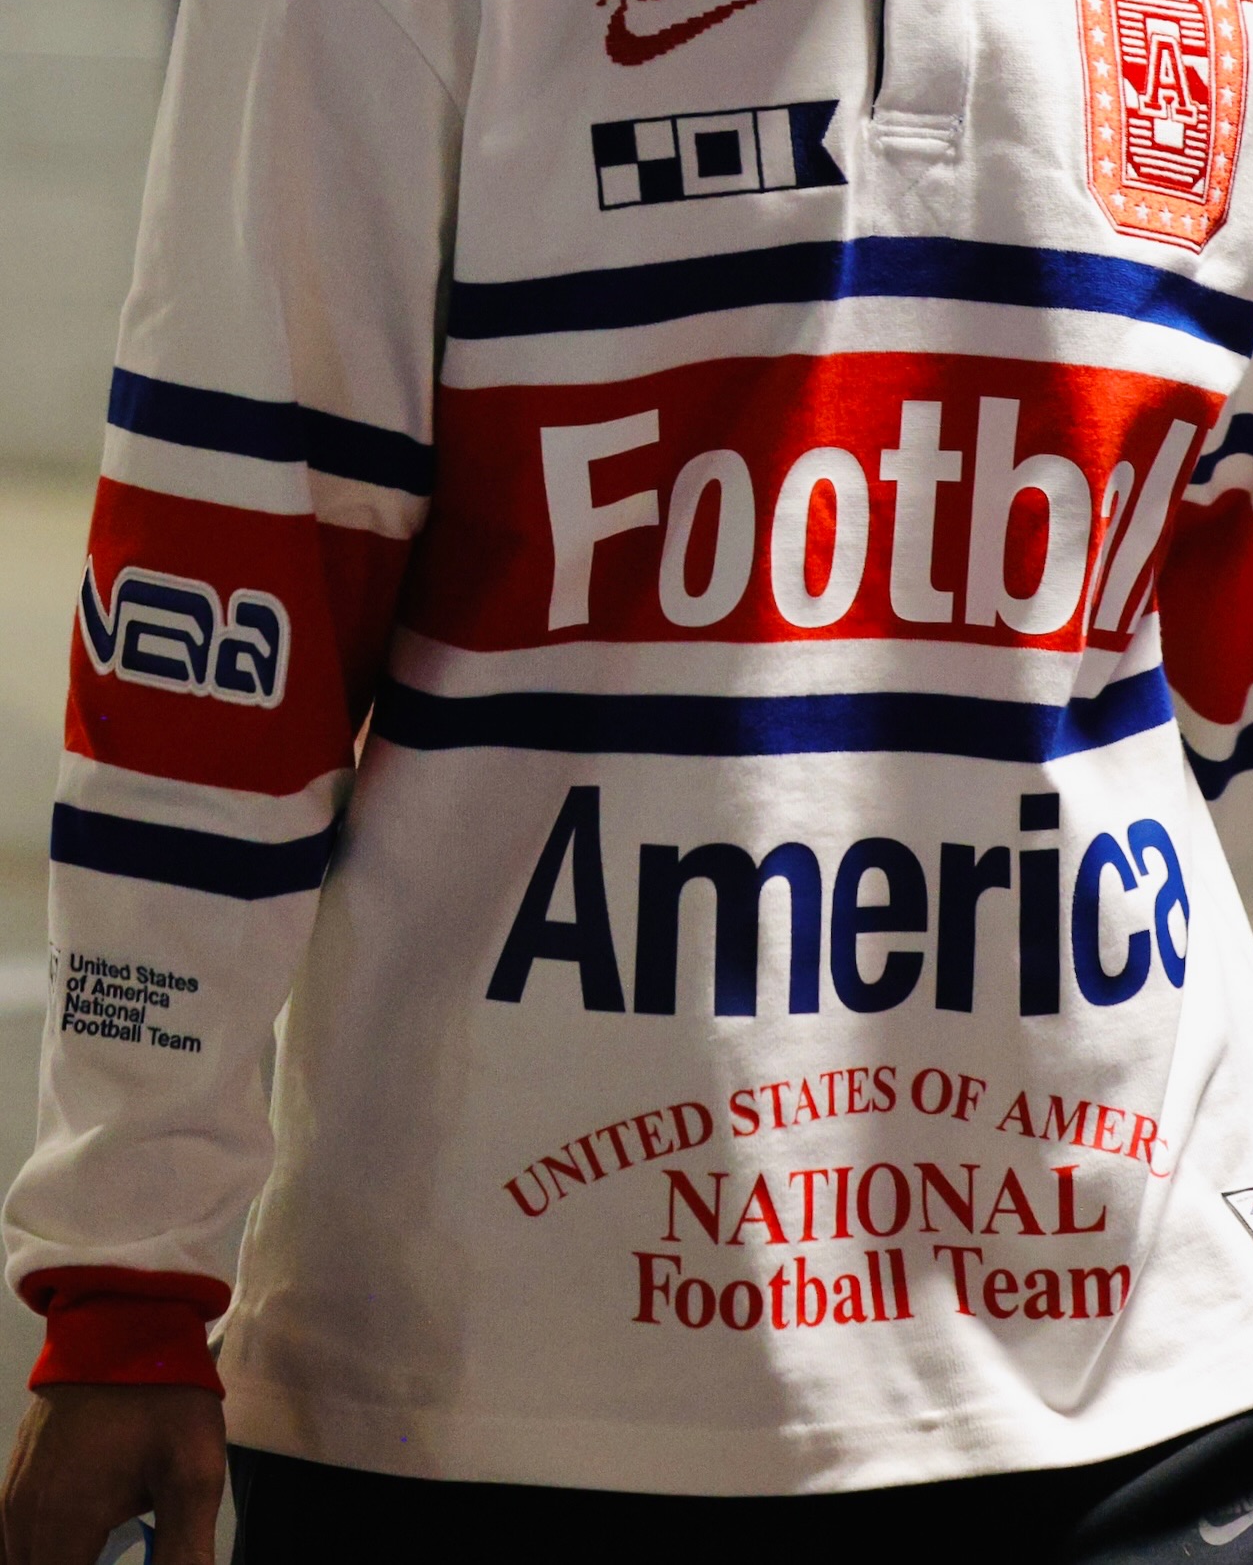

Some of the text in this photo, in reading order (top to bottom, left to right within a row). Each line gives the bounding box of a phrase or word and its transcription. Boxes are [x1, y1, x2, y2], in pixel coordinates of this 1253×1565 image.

[540, 395, 1198, 637] Footbl
[484, 784, 1190, 1017] America
[65, 992, 146, 1024] National
[66, 975, 170, 1009] of America
[69, 952, 200, 993] United States
[61, 1013, 202, 1053] Football Team
[502, 1066, 1172, 1218] UNITED STATES OF AMER
[660, 1162, 1108, 1246] NATIONAL
[631, 1245, 1132, 1331] Football Team
